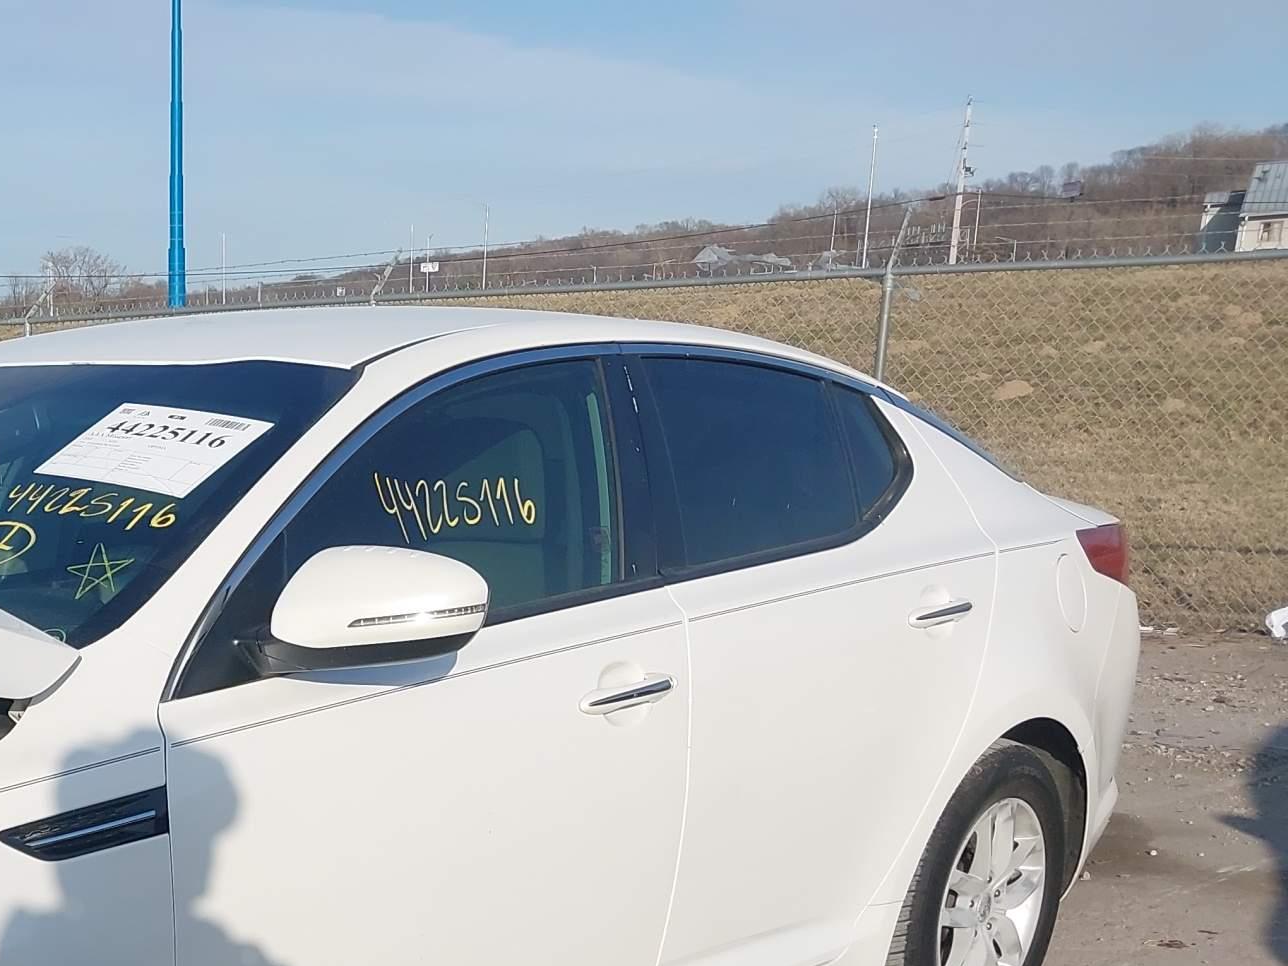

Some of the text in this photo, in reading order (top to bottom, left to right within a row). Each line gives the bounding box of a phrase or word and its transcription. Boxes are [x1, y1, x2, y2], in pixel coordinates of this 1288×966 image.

[107, 420, 232, 449] 44225116
[7, 482, 177, 531] 44225116
[374, 472, 537, 544] 44225116
